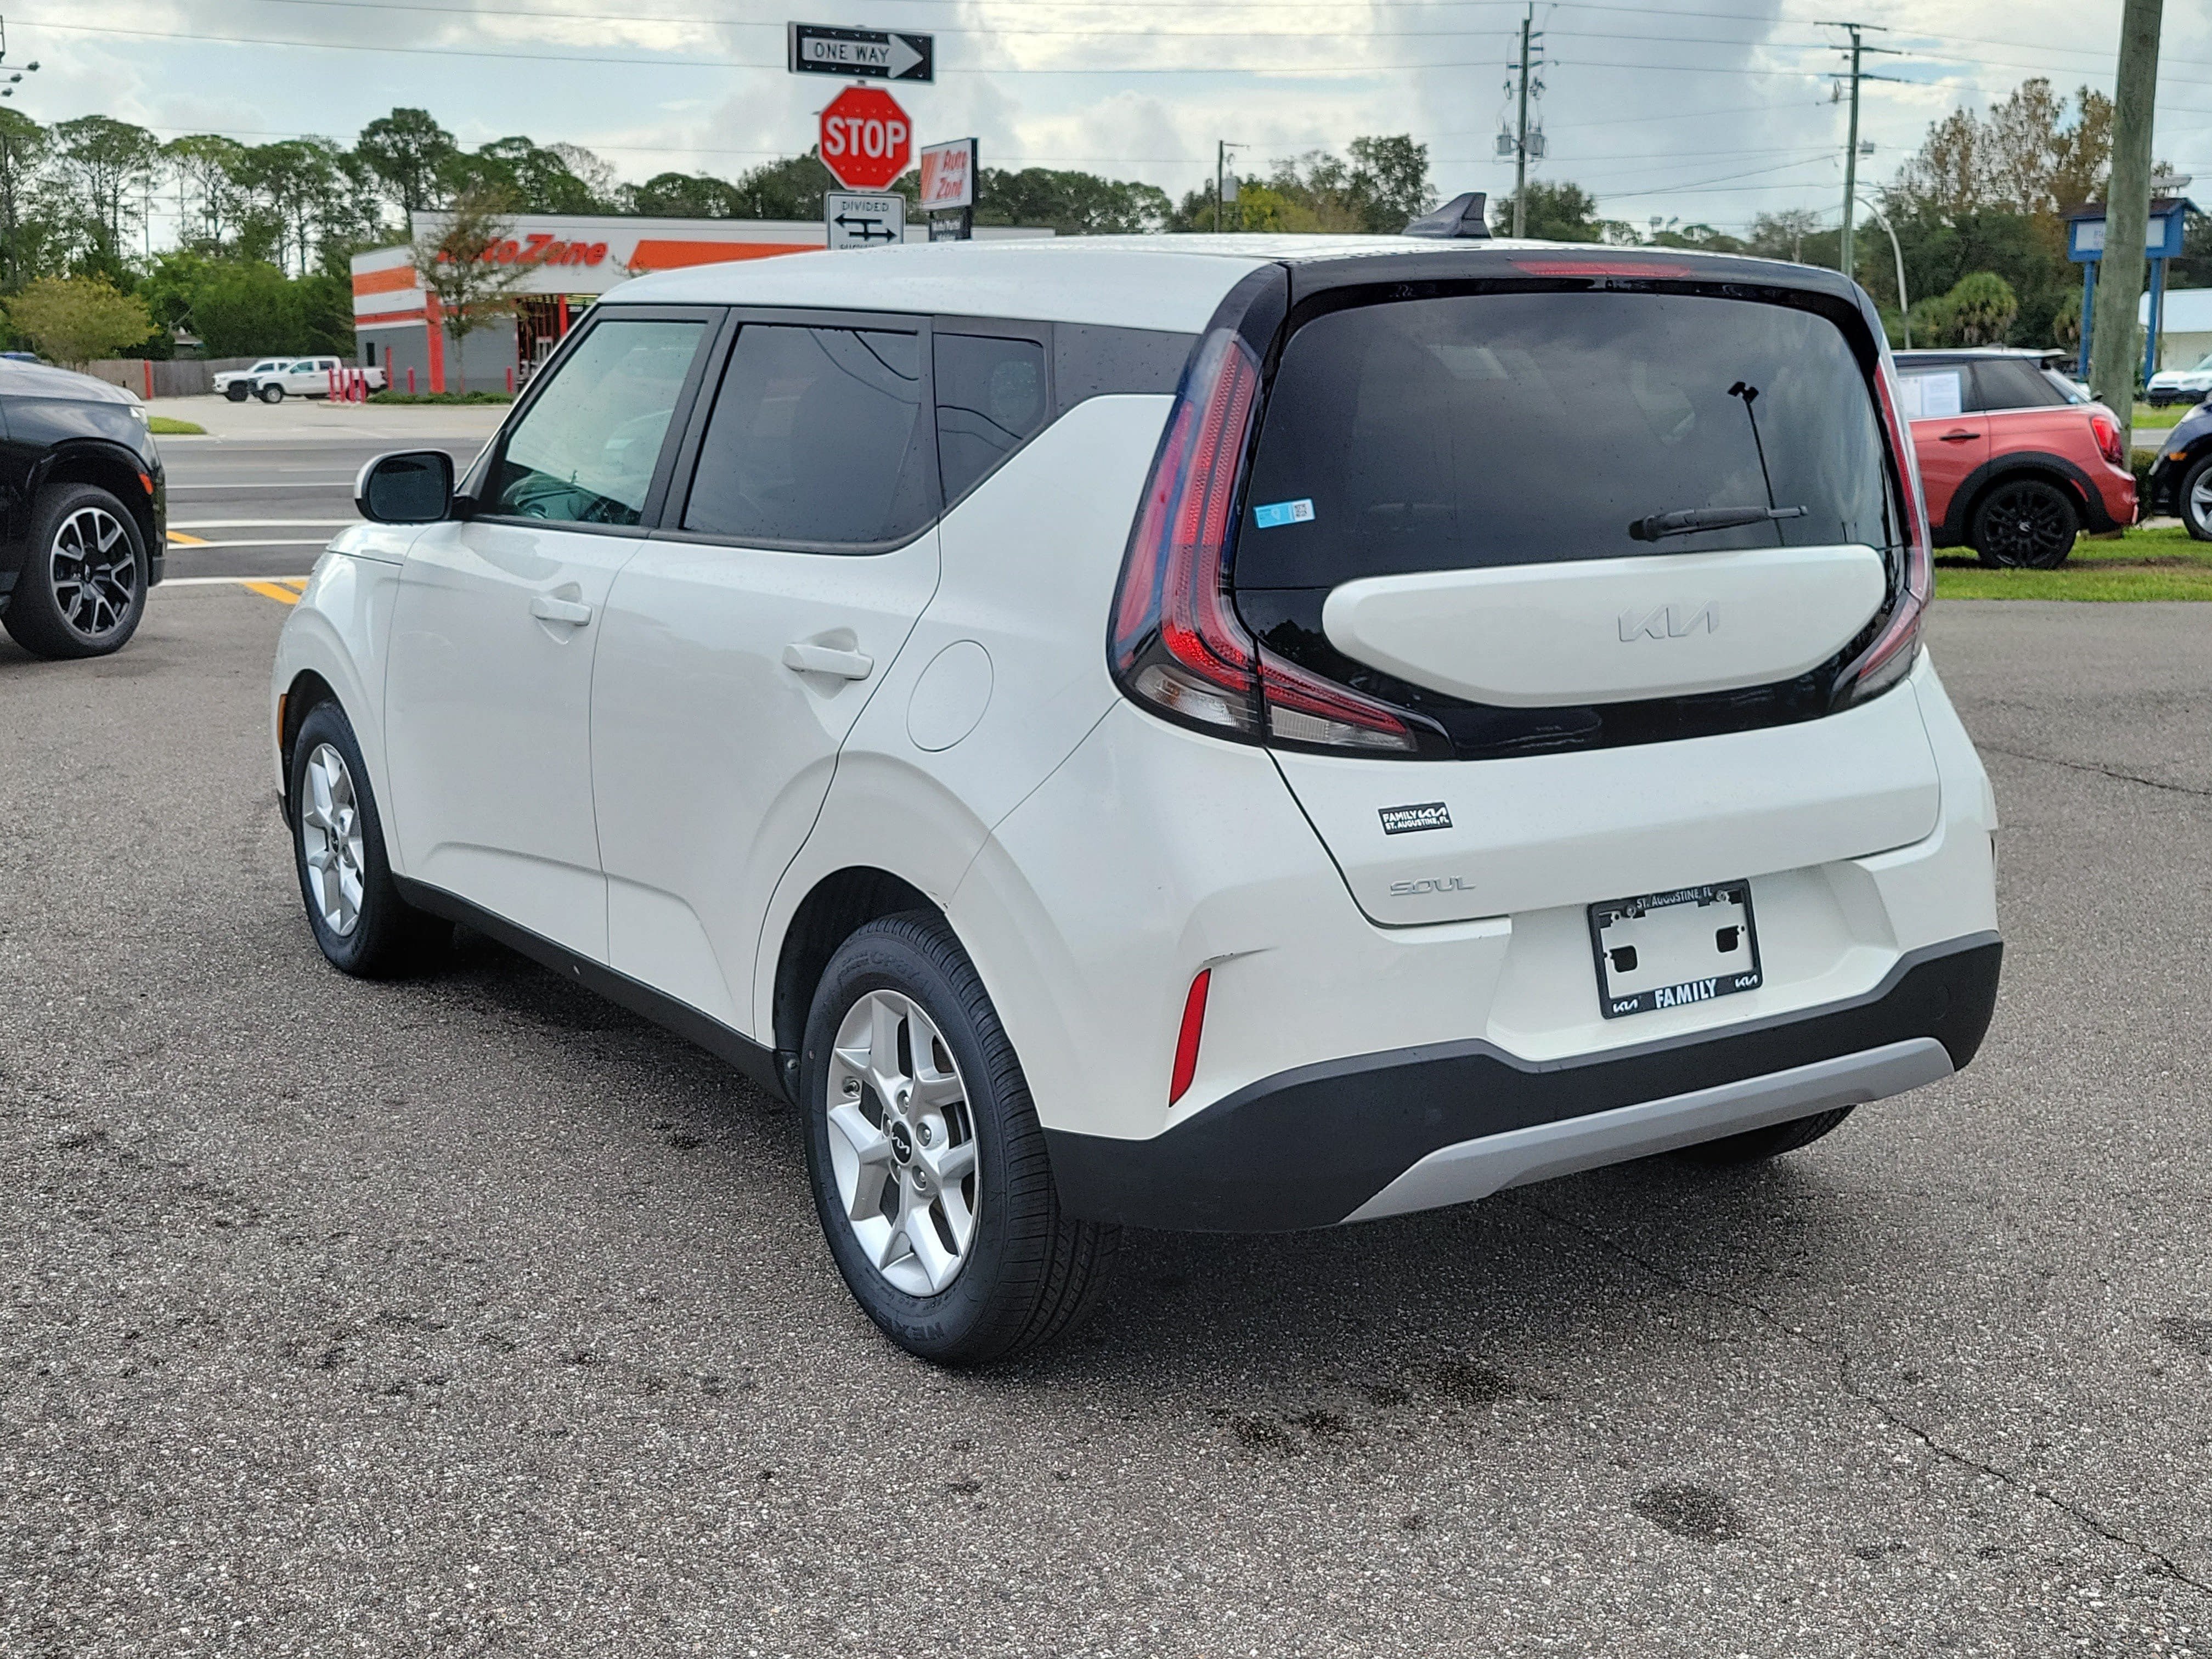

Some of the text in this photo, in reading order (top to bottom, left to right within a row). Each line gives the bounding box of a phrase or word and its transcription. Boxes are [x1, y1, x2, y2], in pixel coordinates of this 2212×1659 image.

[815, 42, 889, 63] ONE WAY
[824, 115, 907, 159] STOP
[842, 201, 889, 212] DIVIDED
[1382, 810, 1417, 823] FAMILY
[1385, 822, 1397, 831] ST.
[1438, 815, 1449, 824] FL
[1390, 875, 1477, 897] SOUL
[1636, 898, 1650, 909] ST.
[1702, 886, 1713, 898] FL
[1654, 978, 1717, 1009] FAMILY
